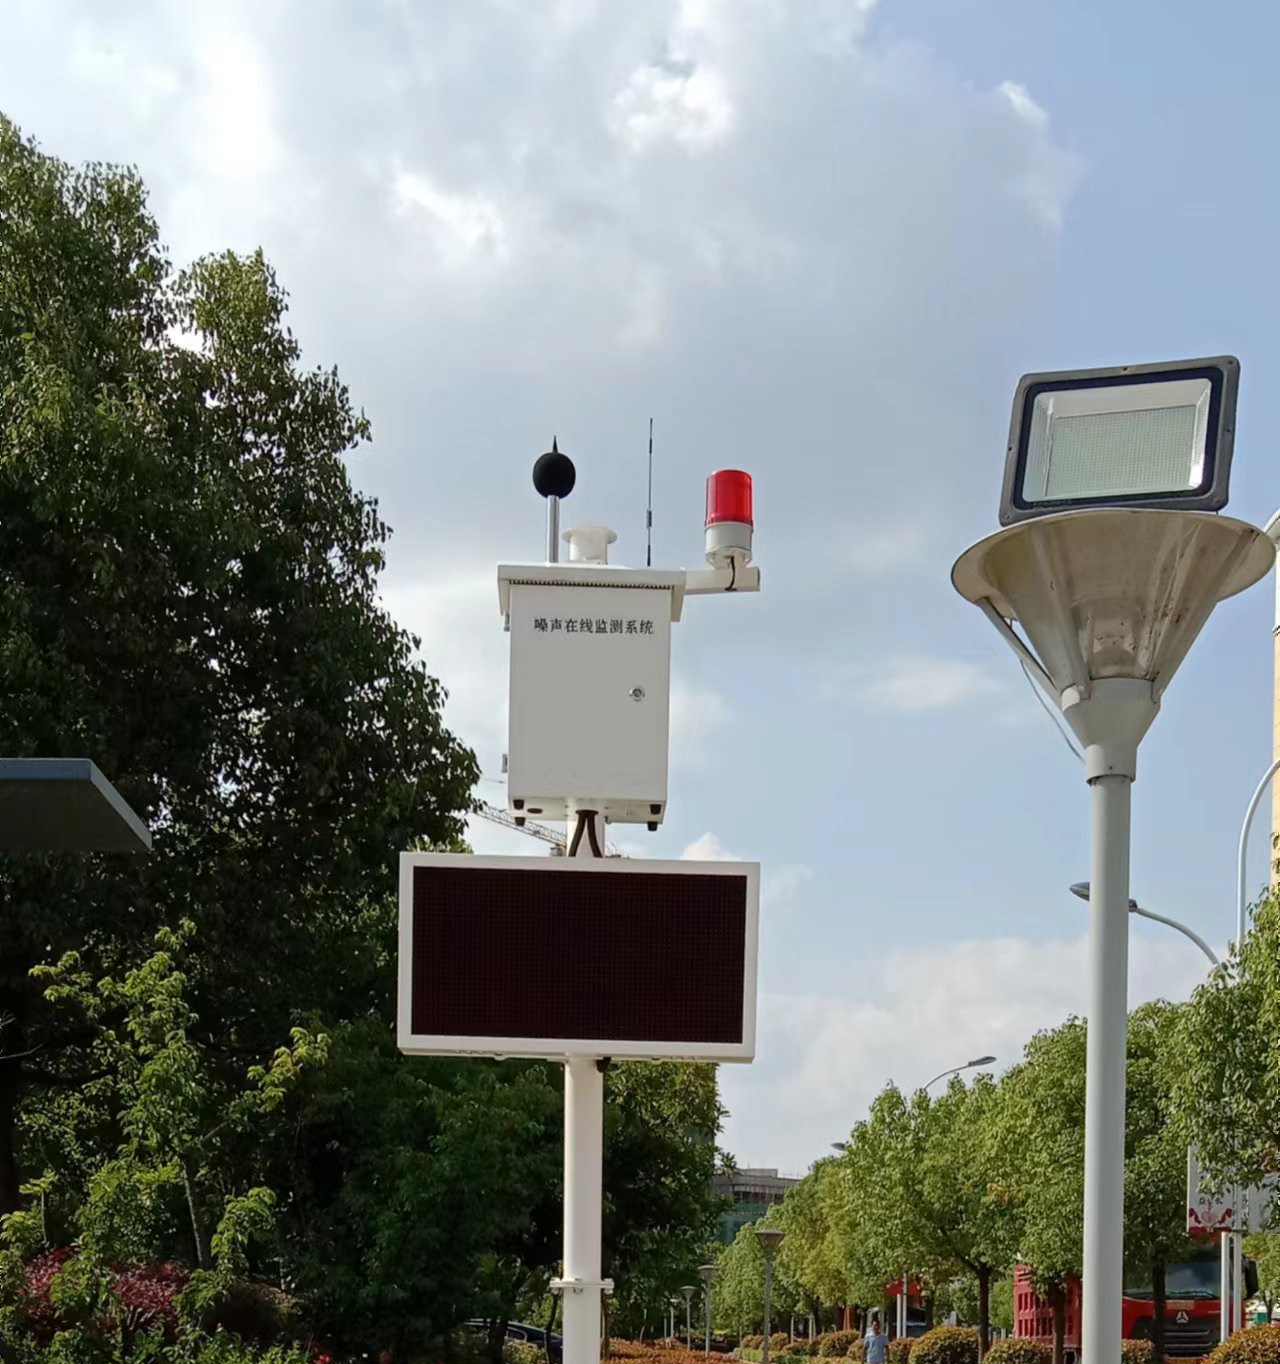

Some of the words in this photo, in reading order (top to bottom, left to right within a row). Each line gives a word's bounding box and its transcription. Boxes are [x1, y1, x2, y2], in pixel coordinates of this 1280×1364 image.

[534, 618, 654, 635] 噪声在线监测系统
